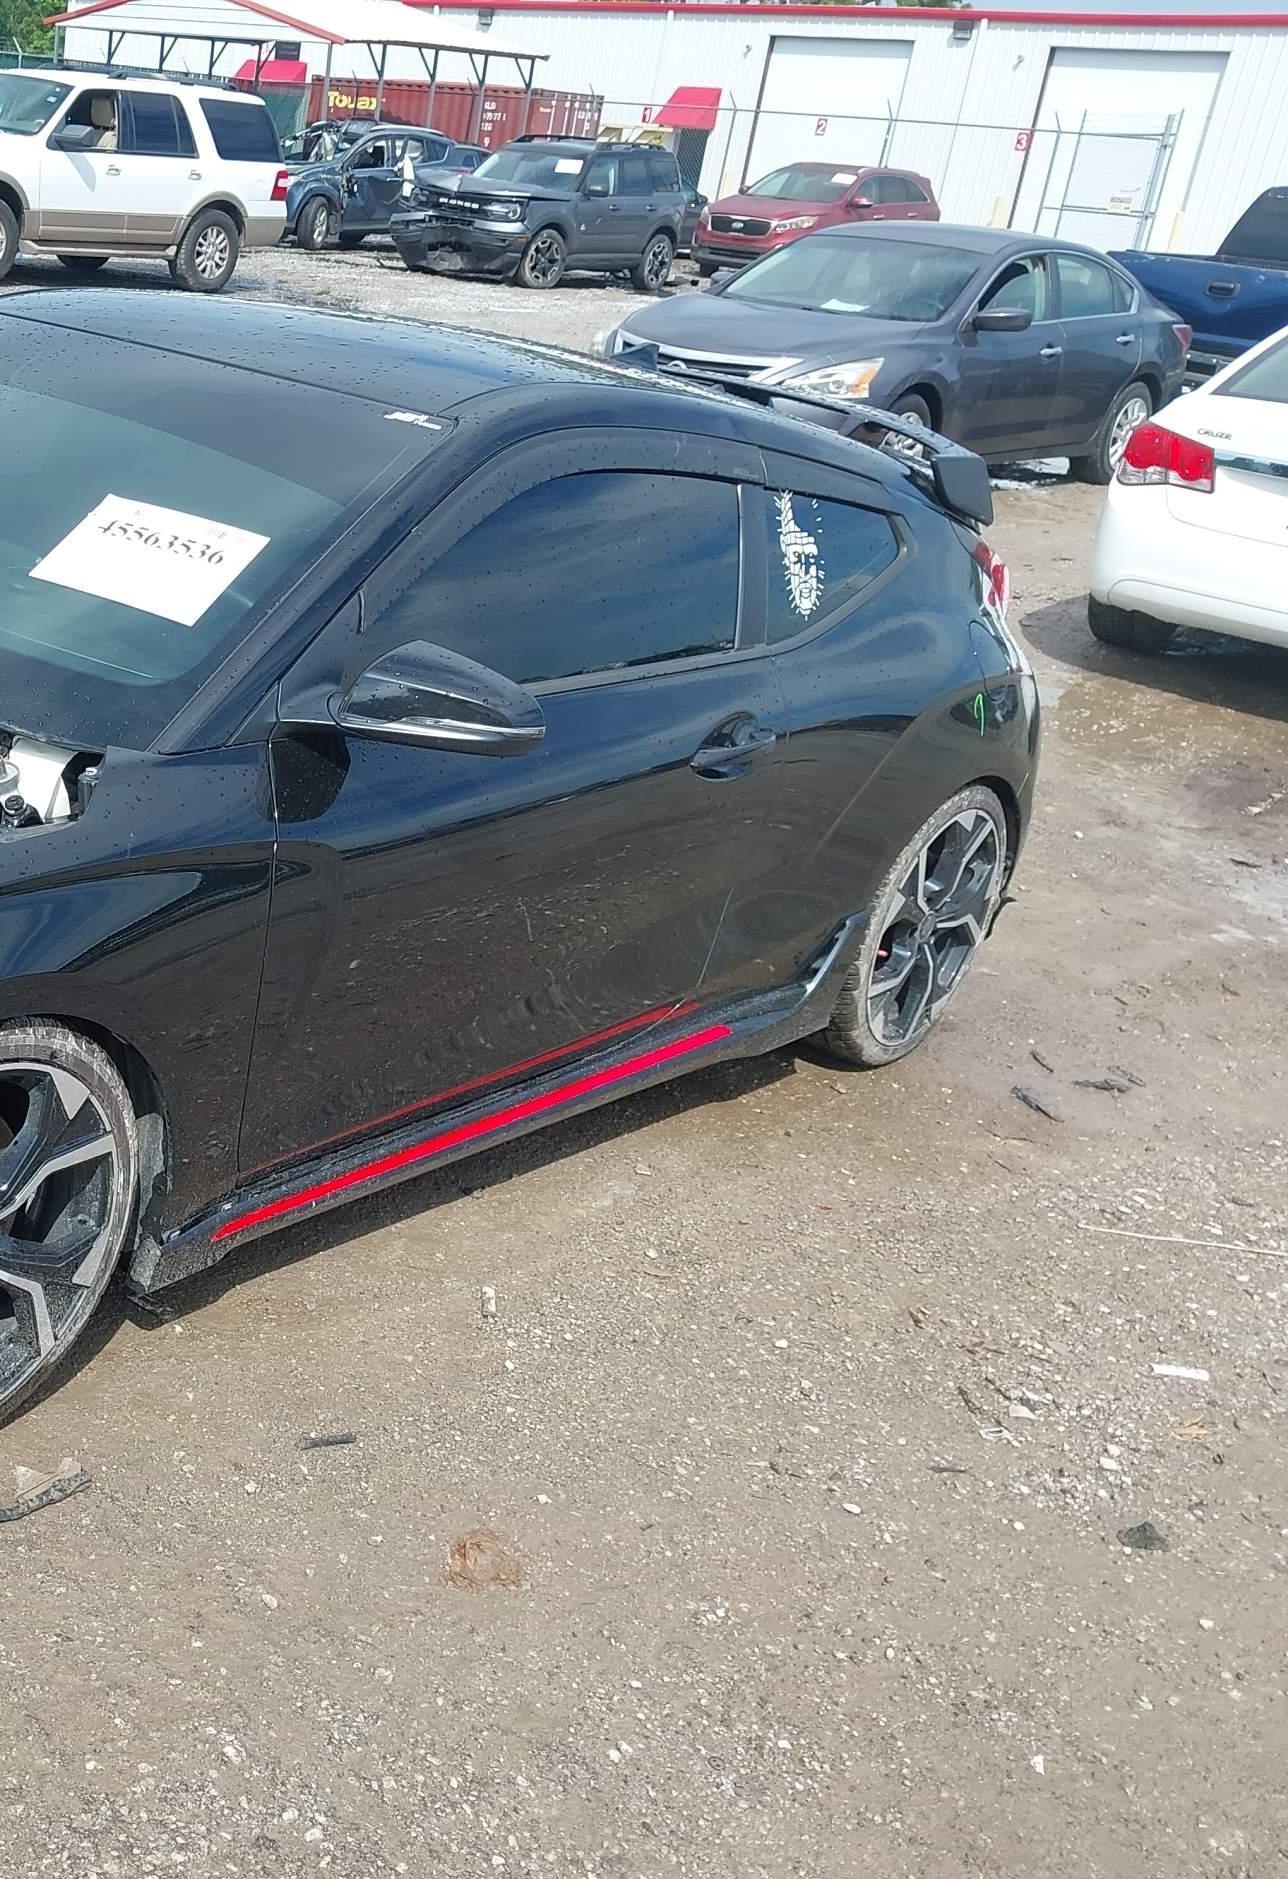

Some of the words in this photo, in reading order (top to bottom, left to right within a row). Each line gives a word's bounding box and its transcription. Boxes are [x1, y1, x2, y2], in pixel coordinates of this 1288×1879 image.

[816, 119, 826, 134] 2
[1016, 133, 1028, 150] 3
[1197, 428, 1232, 440] CRUZE
[98, 520, 224, 565] 45563536
